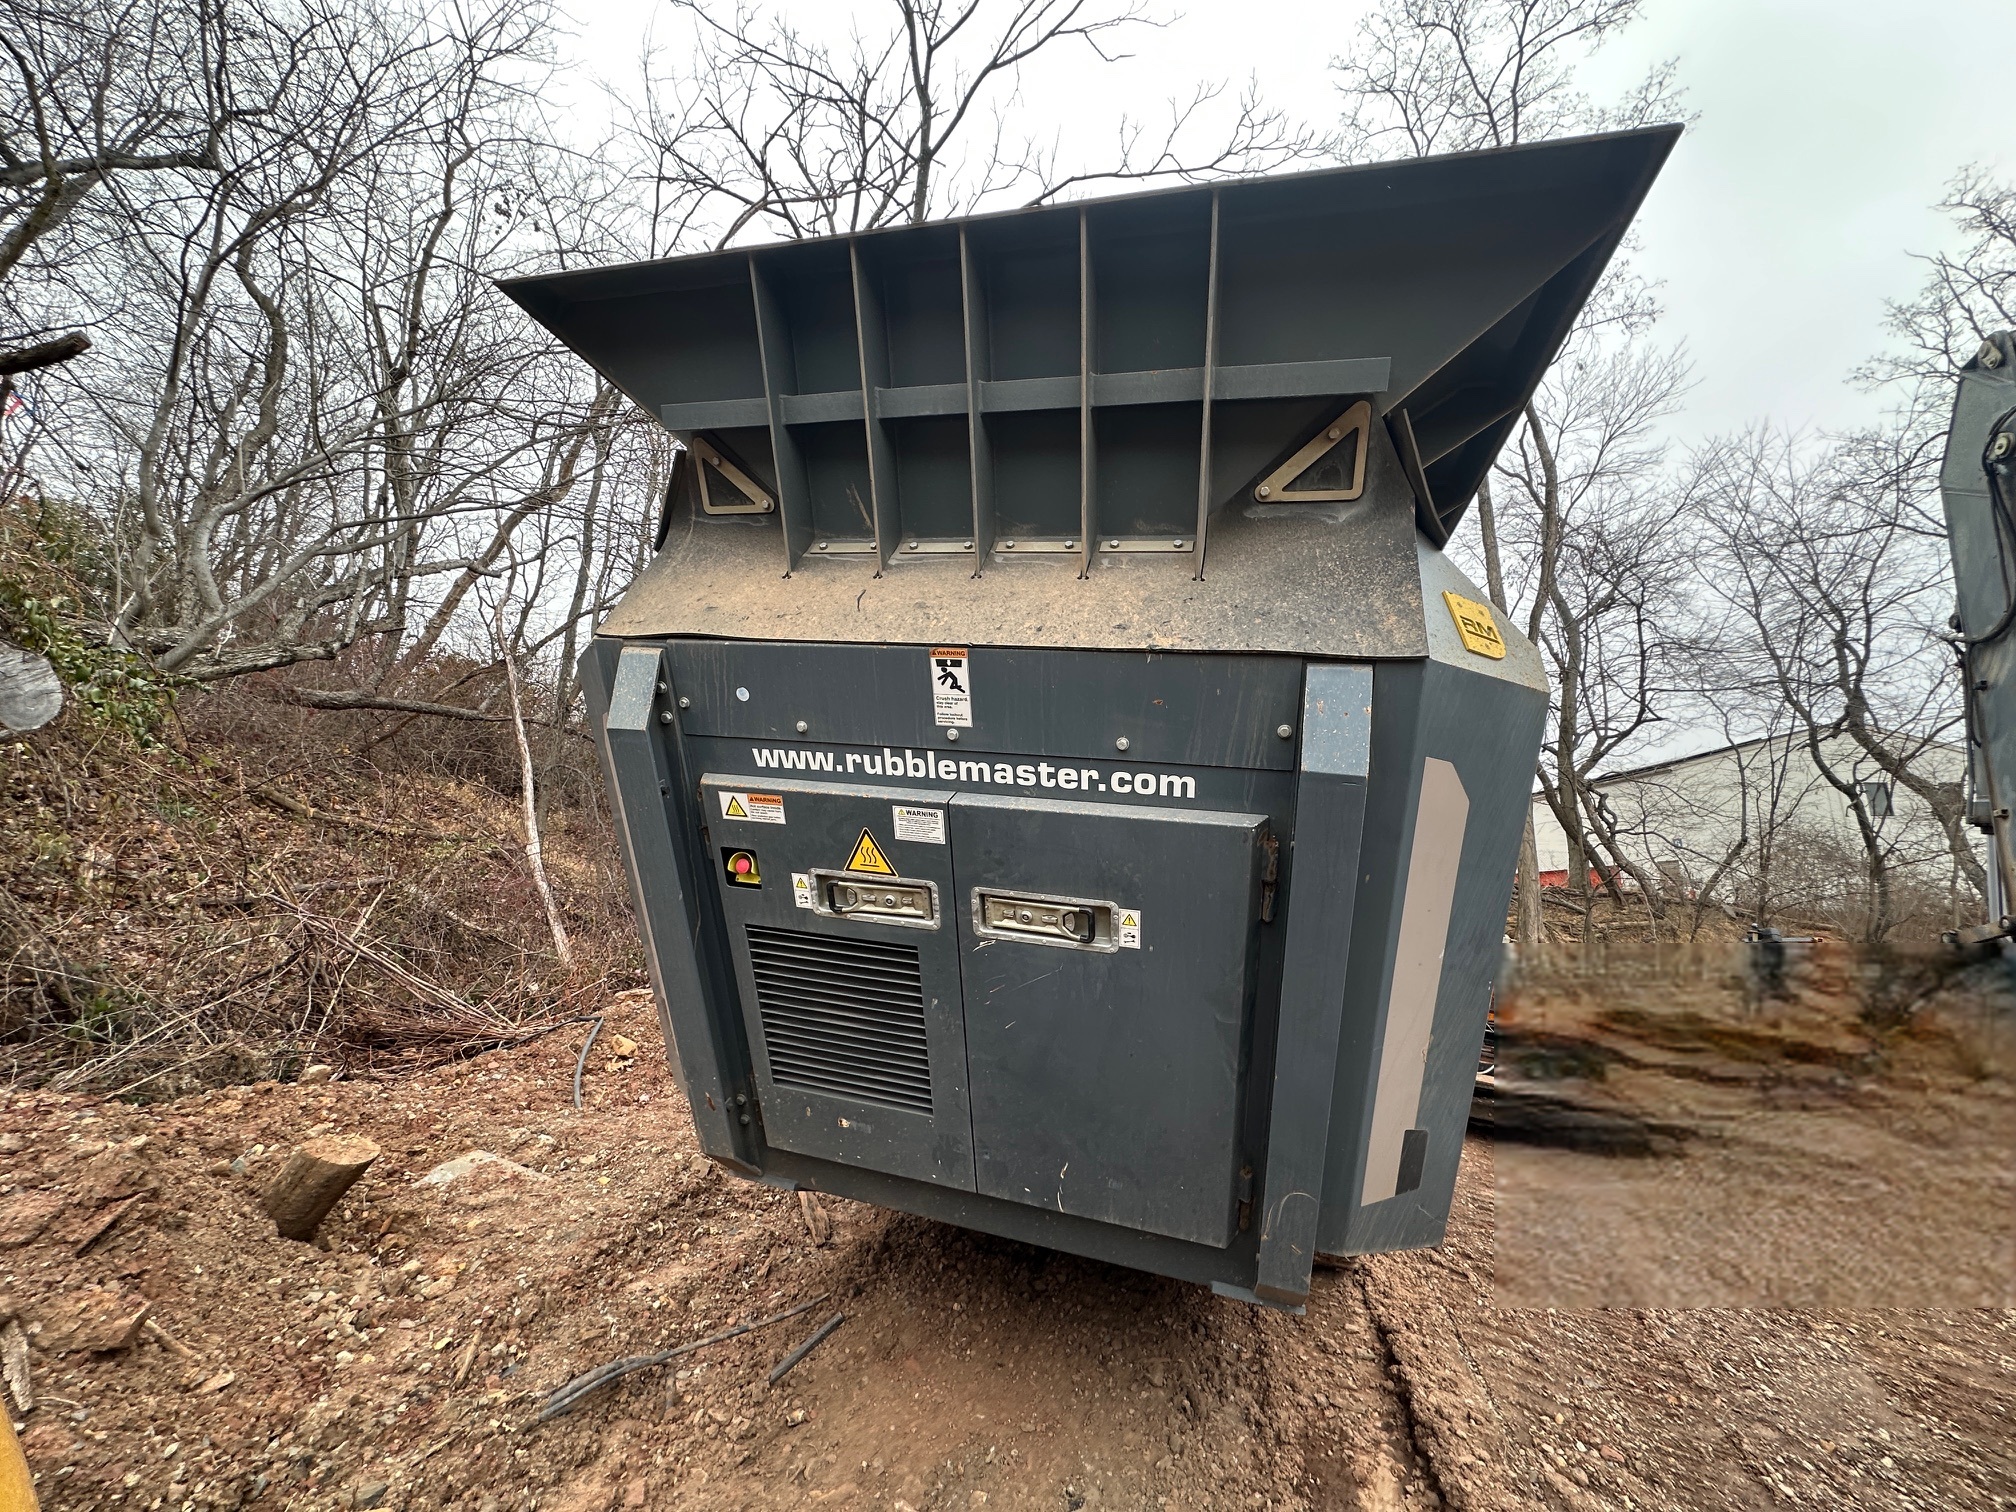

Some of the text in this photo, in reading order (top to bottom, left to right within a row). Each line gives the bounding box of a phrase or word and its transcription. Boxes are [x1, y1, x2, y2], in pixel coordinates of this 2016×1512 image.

[1460, 615, 1498, 640] RM
[752, 748, 1195, 799] www.rubblemaster.com
[754, 796, 782, 804] WARNING
[905, 809, 939, 819] WARNING
